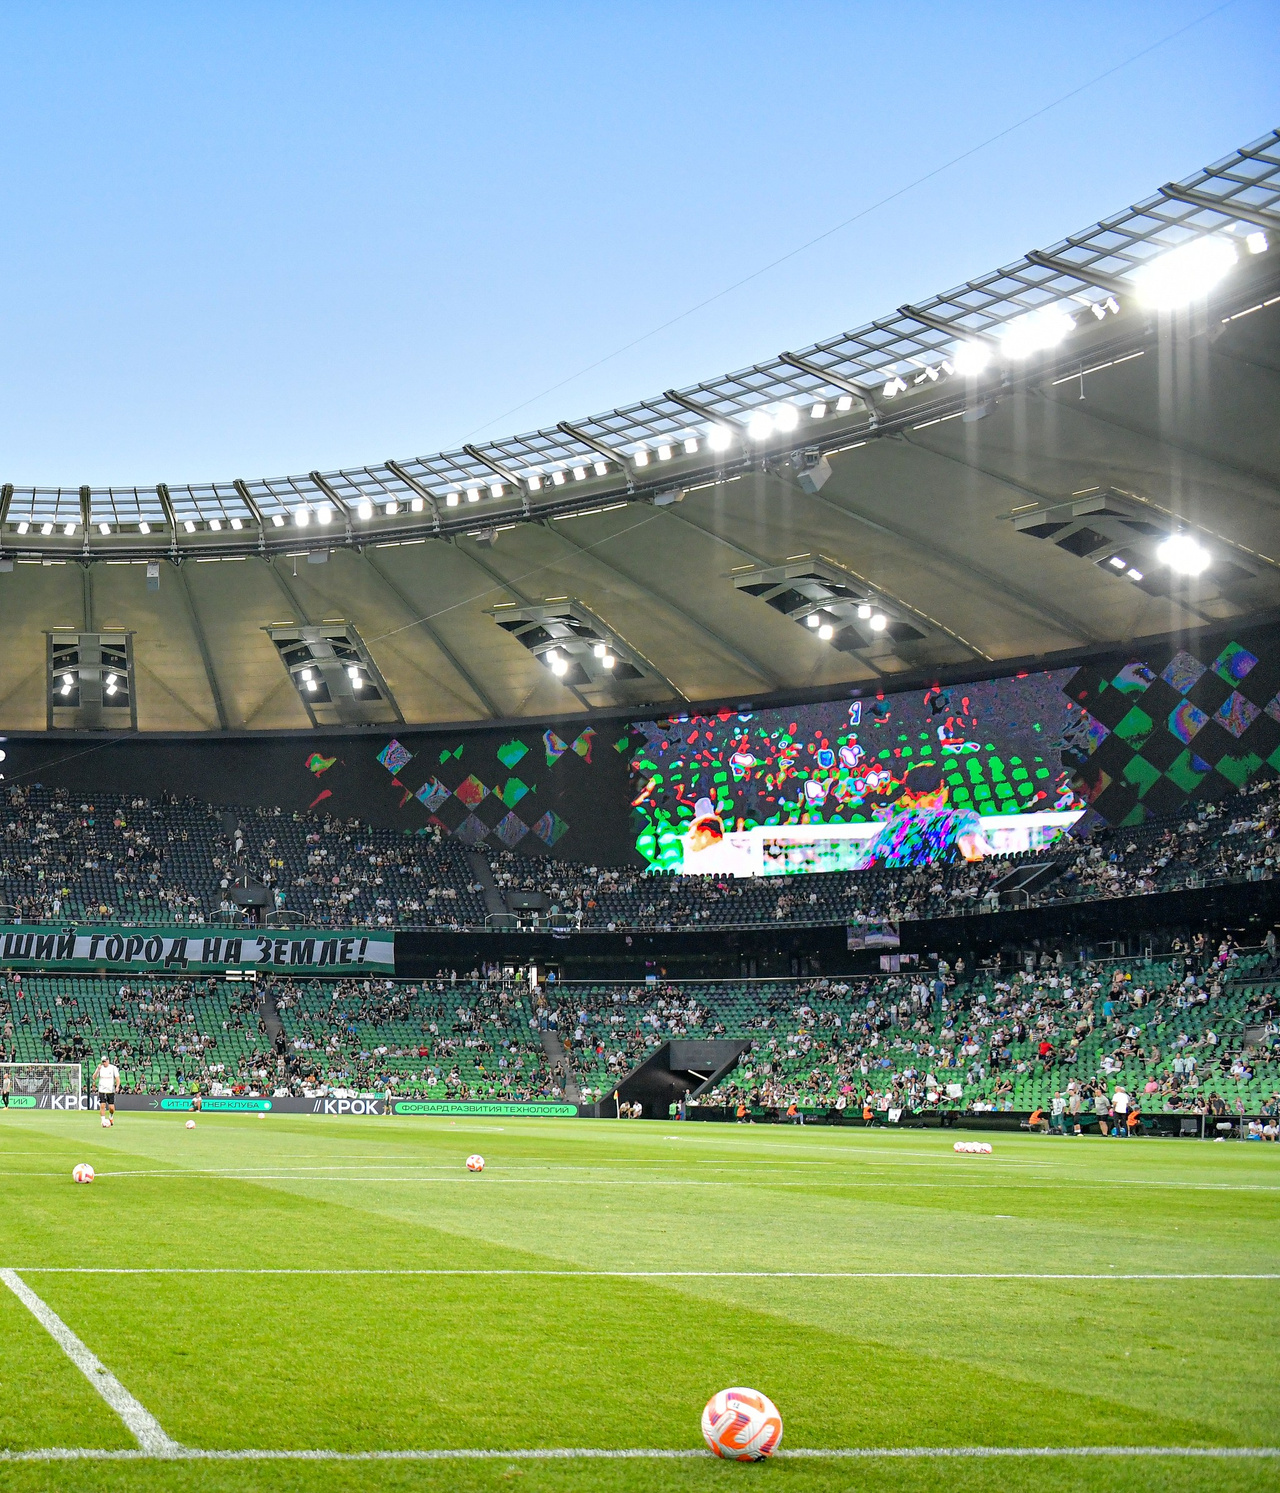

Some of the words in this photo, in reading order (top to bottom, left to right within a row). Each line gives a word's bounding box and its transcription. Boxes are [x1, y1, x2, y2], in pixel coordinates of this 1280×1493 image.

[88, 933, 190, 969] ГОРОД
[201, 937, 244, 965] НА
[255, 935, 369, 967] ЗЕМЛЕ!
[401, 1104, 450, 1113] ФОРВАРД
[450, 1105, 502, 1113] РАЗВИТИЯ
[503, 1105, 569, 1114] ТЕХНОЛОГИЙ
